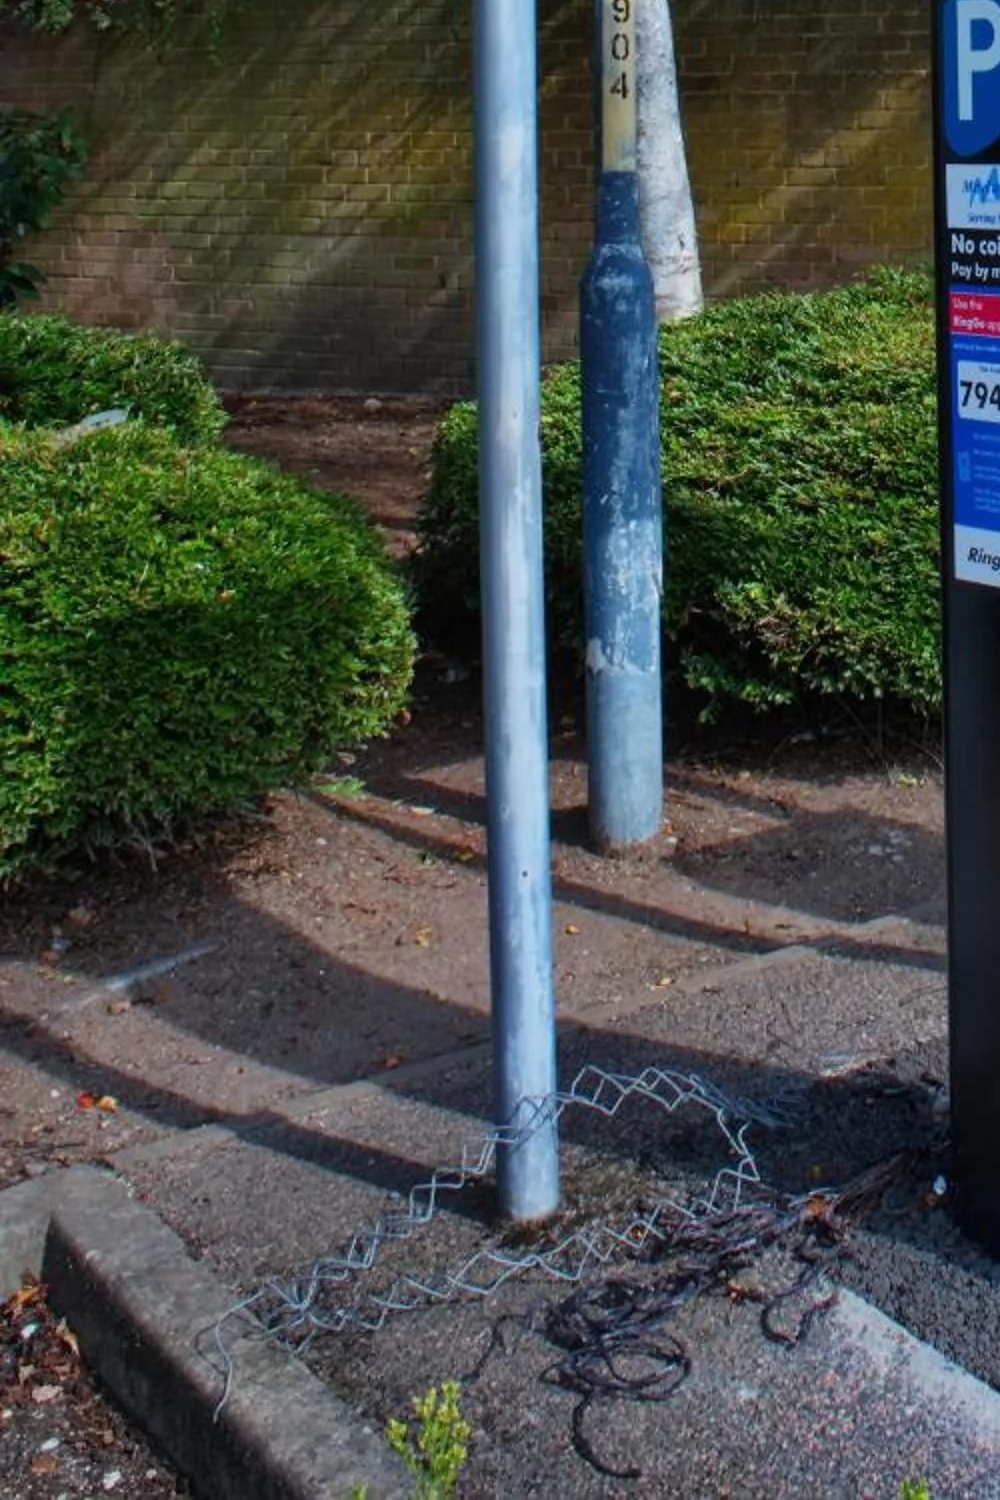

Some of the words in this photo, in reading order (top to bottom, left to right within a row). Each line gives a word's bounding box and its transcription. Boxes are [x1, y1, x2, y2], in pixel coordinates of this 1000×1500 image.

[951, 234, 974, 255] No
[951, 262, 971, 280] Pay
[975, 264, 988, 282] by
